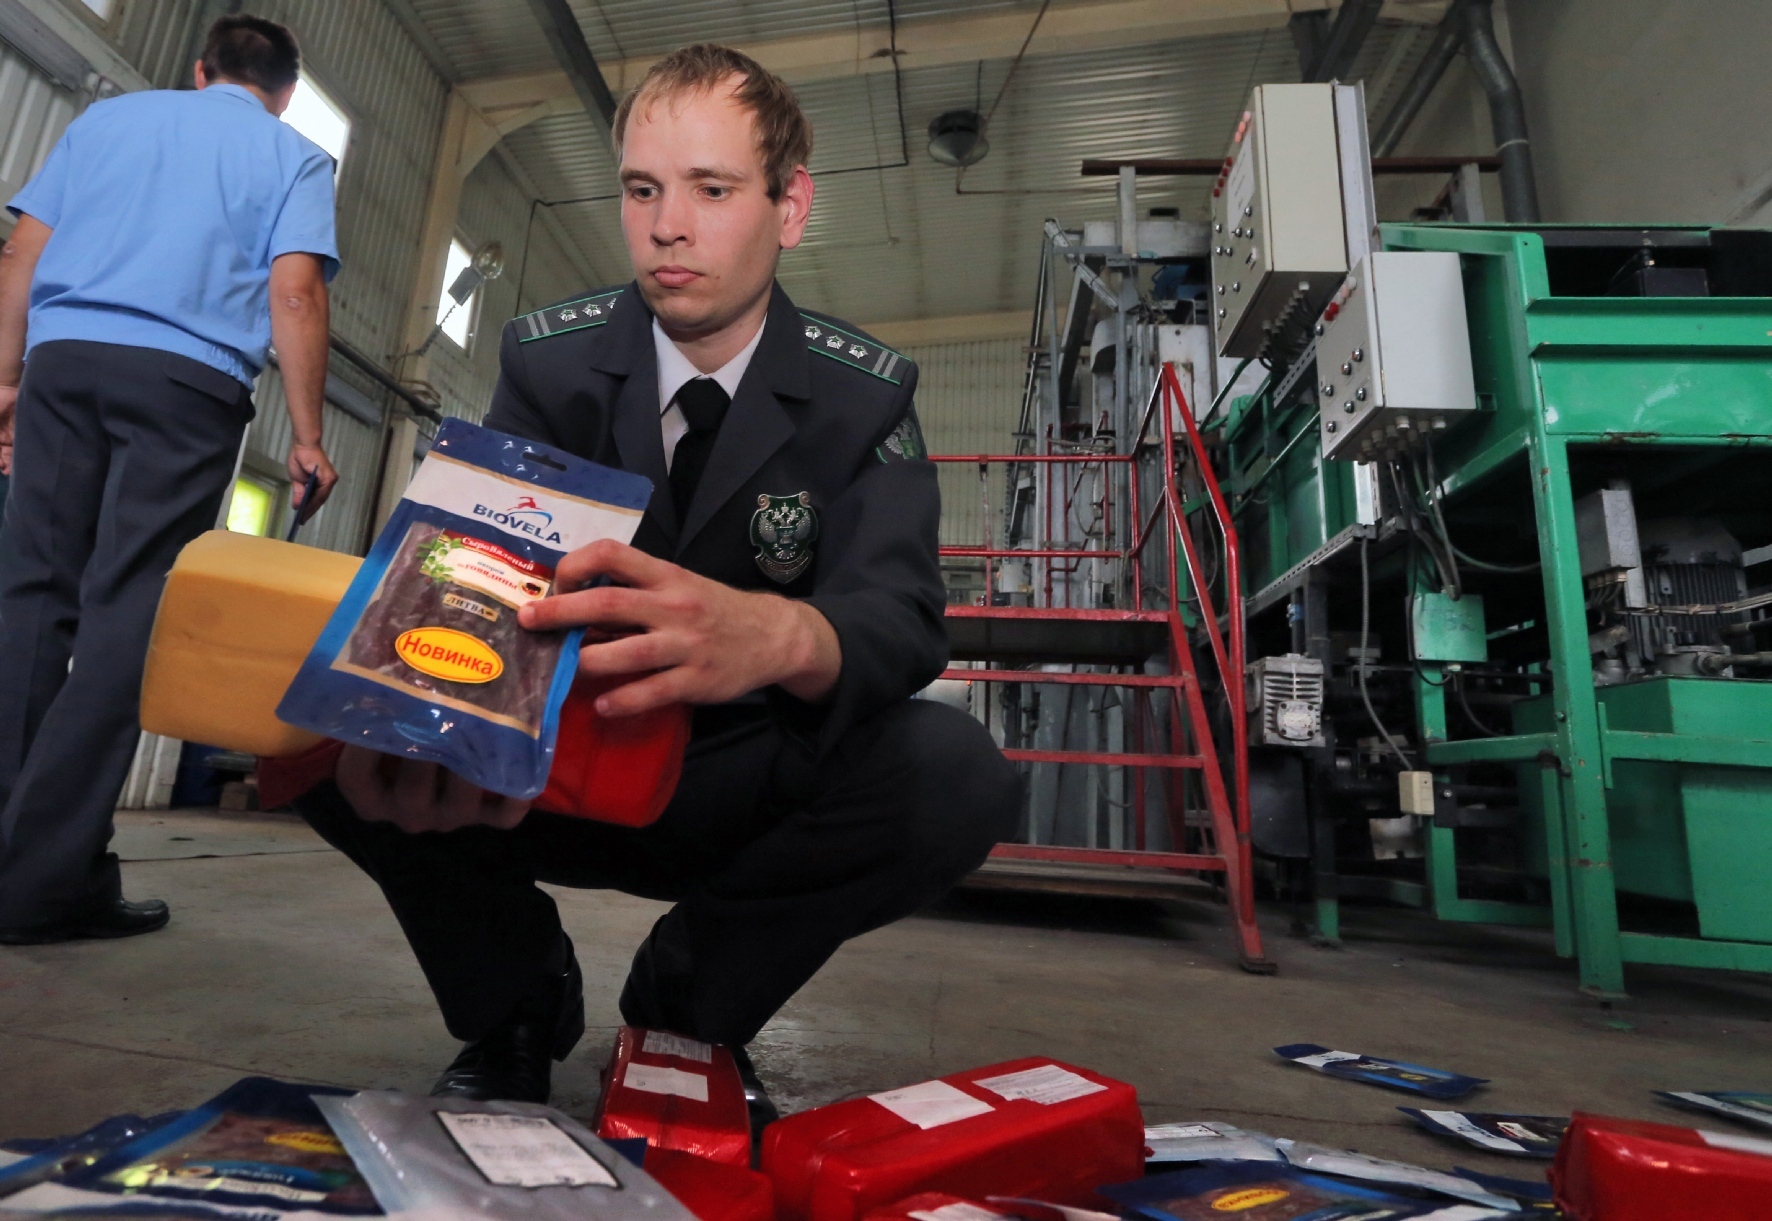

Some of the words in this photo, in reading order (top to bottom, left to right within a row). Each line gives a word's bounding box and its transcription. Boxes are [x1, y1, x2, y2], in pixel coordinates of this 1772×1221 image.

[473, 503, 561, 544] BIOVELA
[446, 596, 486, 615] ЛИТВА
[403, 635, 493, 675] Новинка
